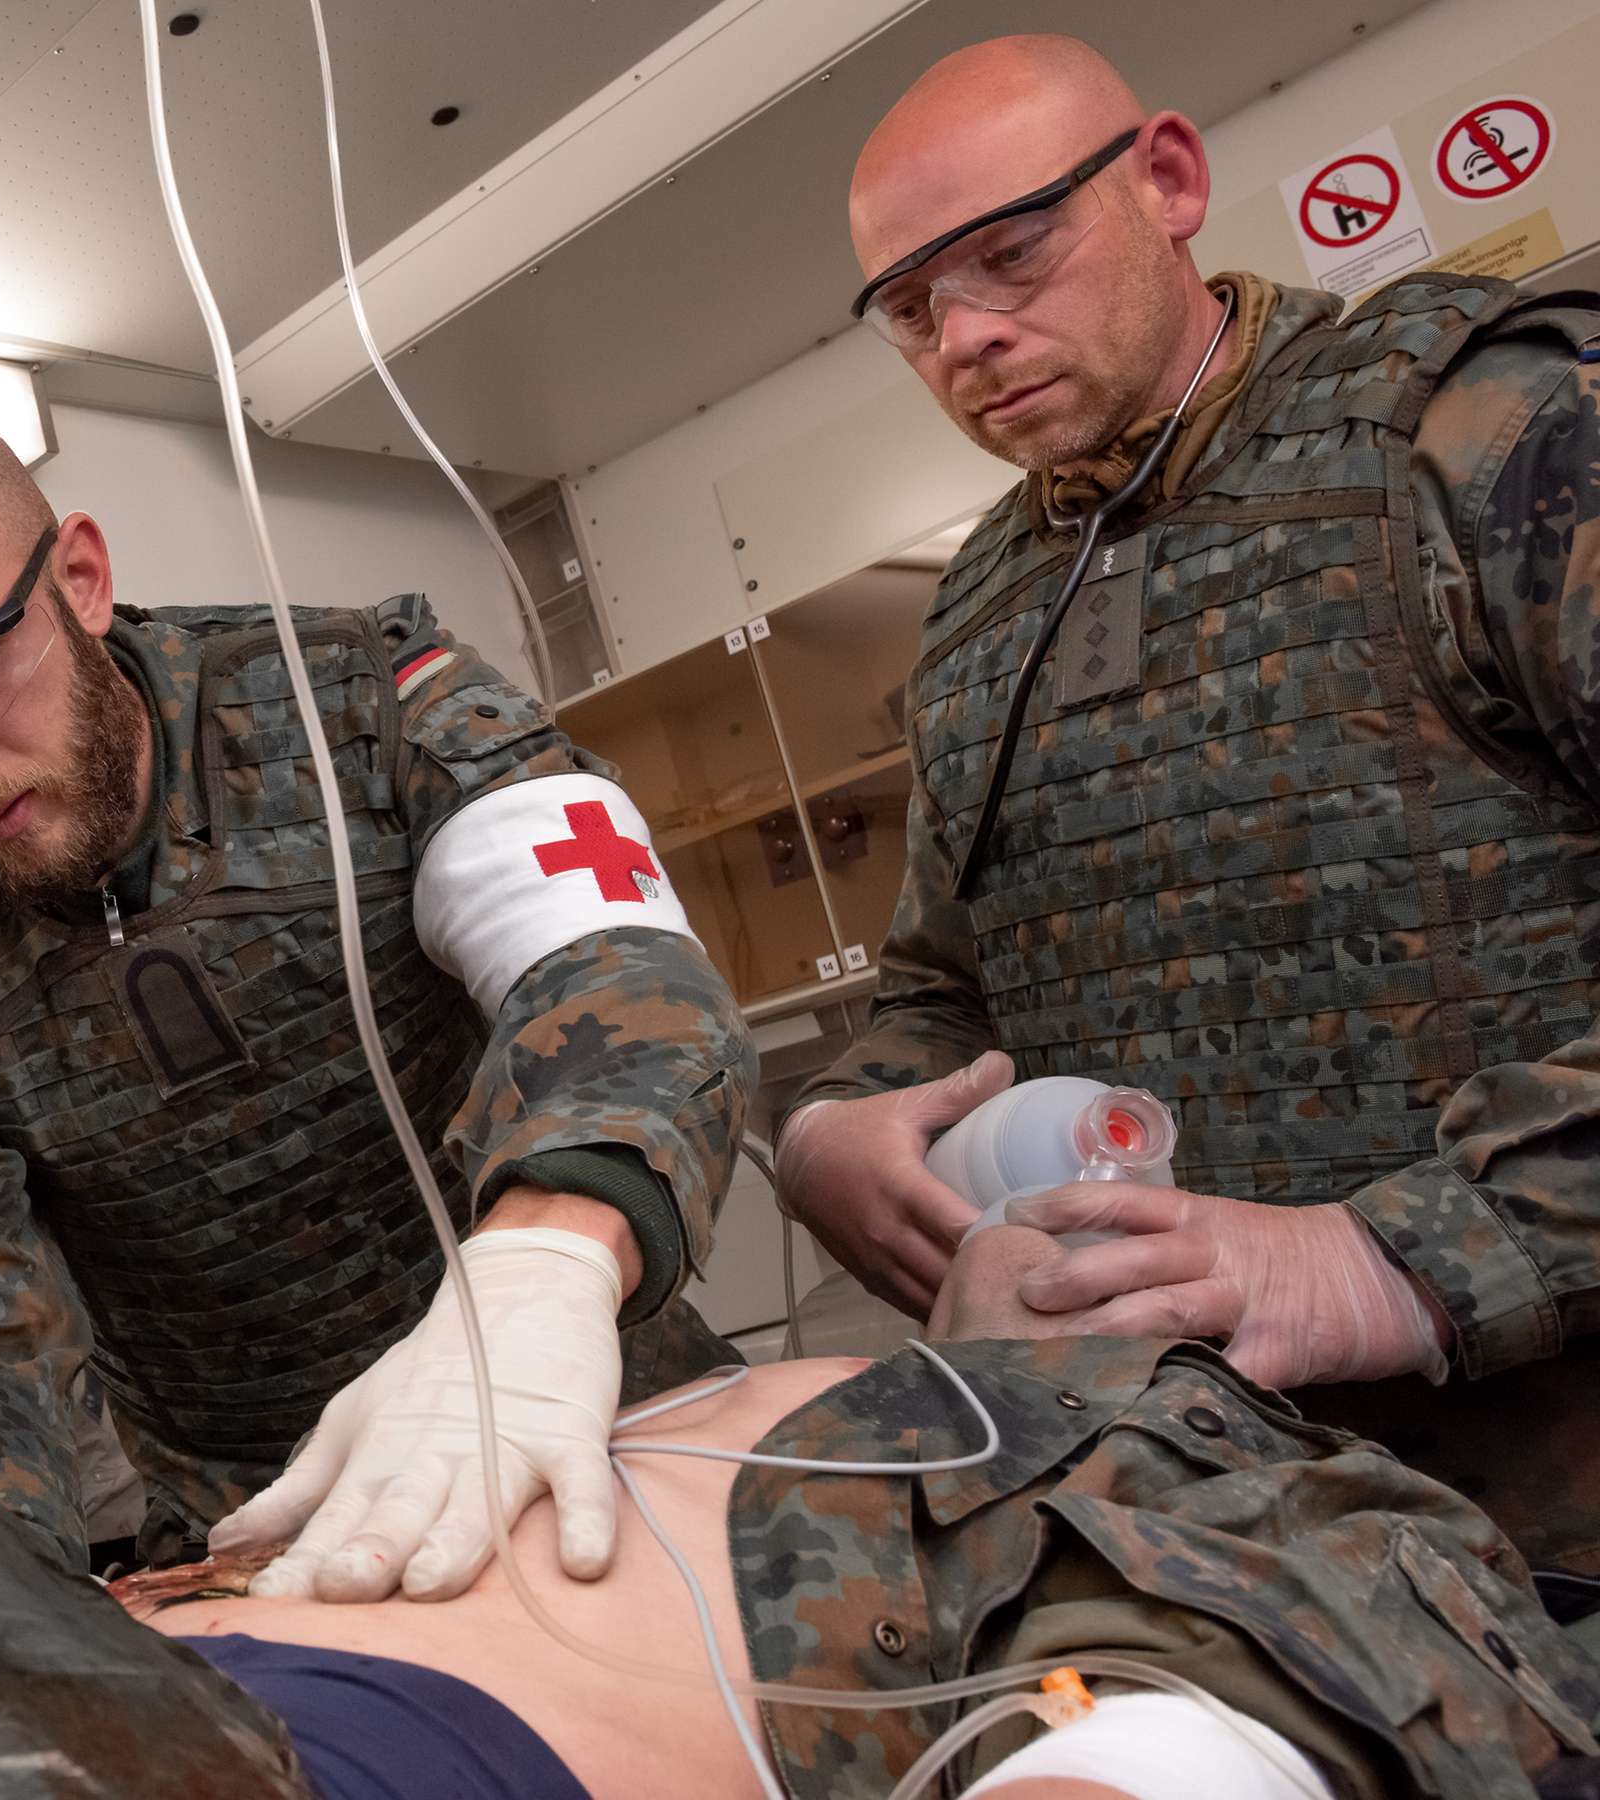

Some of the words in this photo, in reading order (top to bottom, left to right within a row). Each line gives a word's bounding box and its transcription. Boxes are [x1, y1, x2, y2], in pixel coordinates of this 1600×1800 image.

[754, 623, 765, 634] 15
[731, 635, 741, 647] 13
[850, 951, 862, 963] 16
[823, 961, 834, 972] 14
